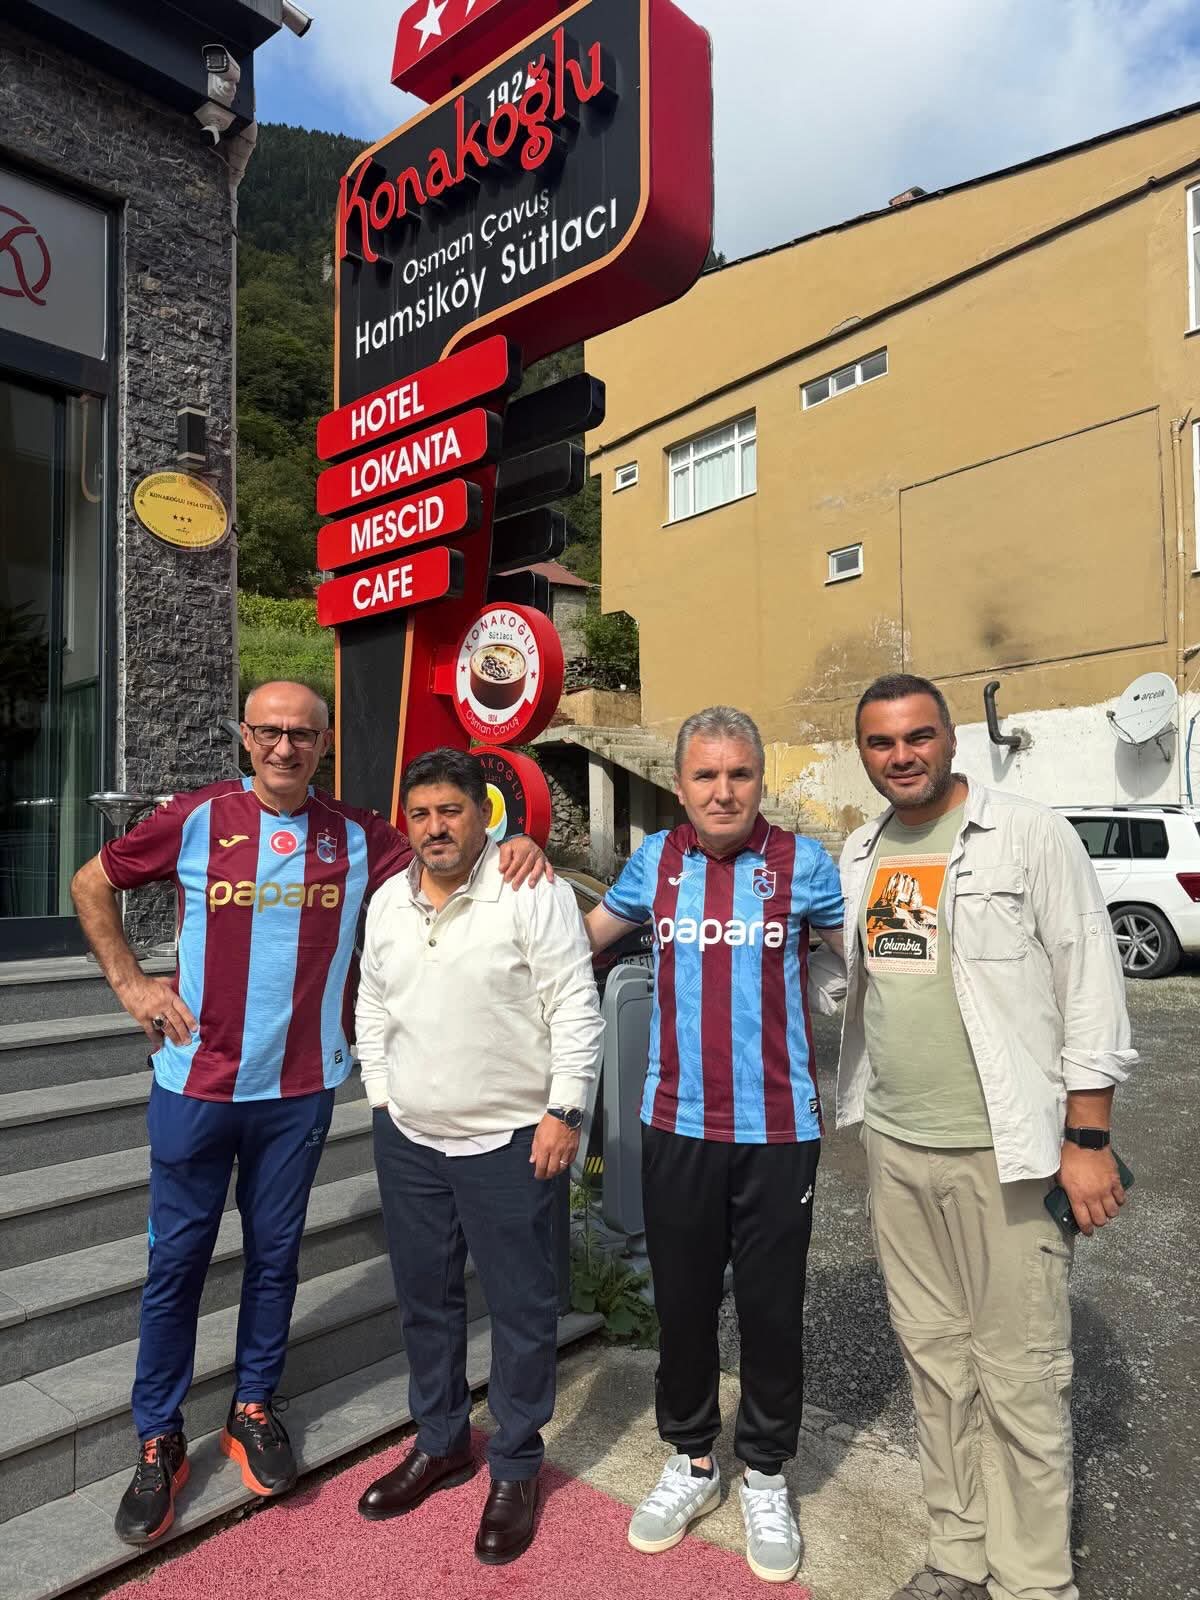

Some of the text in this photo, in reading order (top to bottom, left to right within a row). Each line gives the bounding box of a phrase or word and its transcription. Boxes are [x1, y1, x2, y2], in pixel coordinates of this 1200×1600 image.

[339, 26, 604, 263] Konakoğlu
[403, 188, 550, 286] Osman Çavuş
[355, 197, 618, 359] Hamsiköy Sütlacı
[351, 381, 425, 441] HOTEL
[351, 427, 461, 498] LOKANTA
[352, 564, 413, 611] CAFE
[464, 613, 536, 655] KONAKOĞLU
[465, 709, 520, 737] Osman Çavuş
[480, 757, 523, 801] AKOĞLU
[209, 880, 340, 913] papara
[657, 917, 784, 952] papara
[878, 937, 923, 956] Columbia
